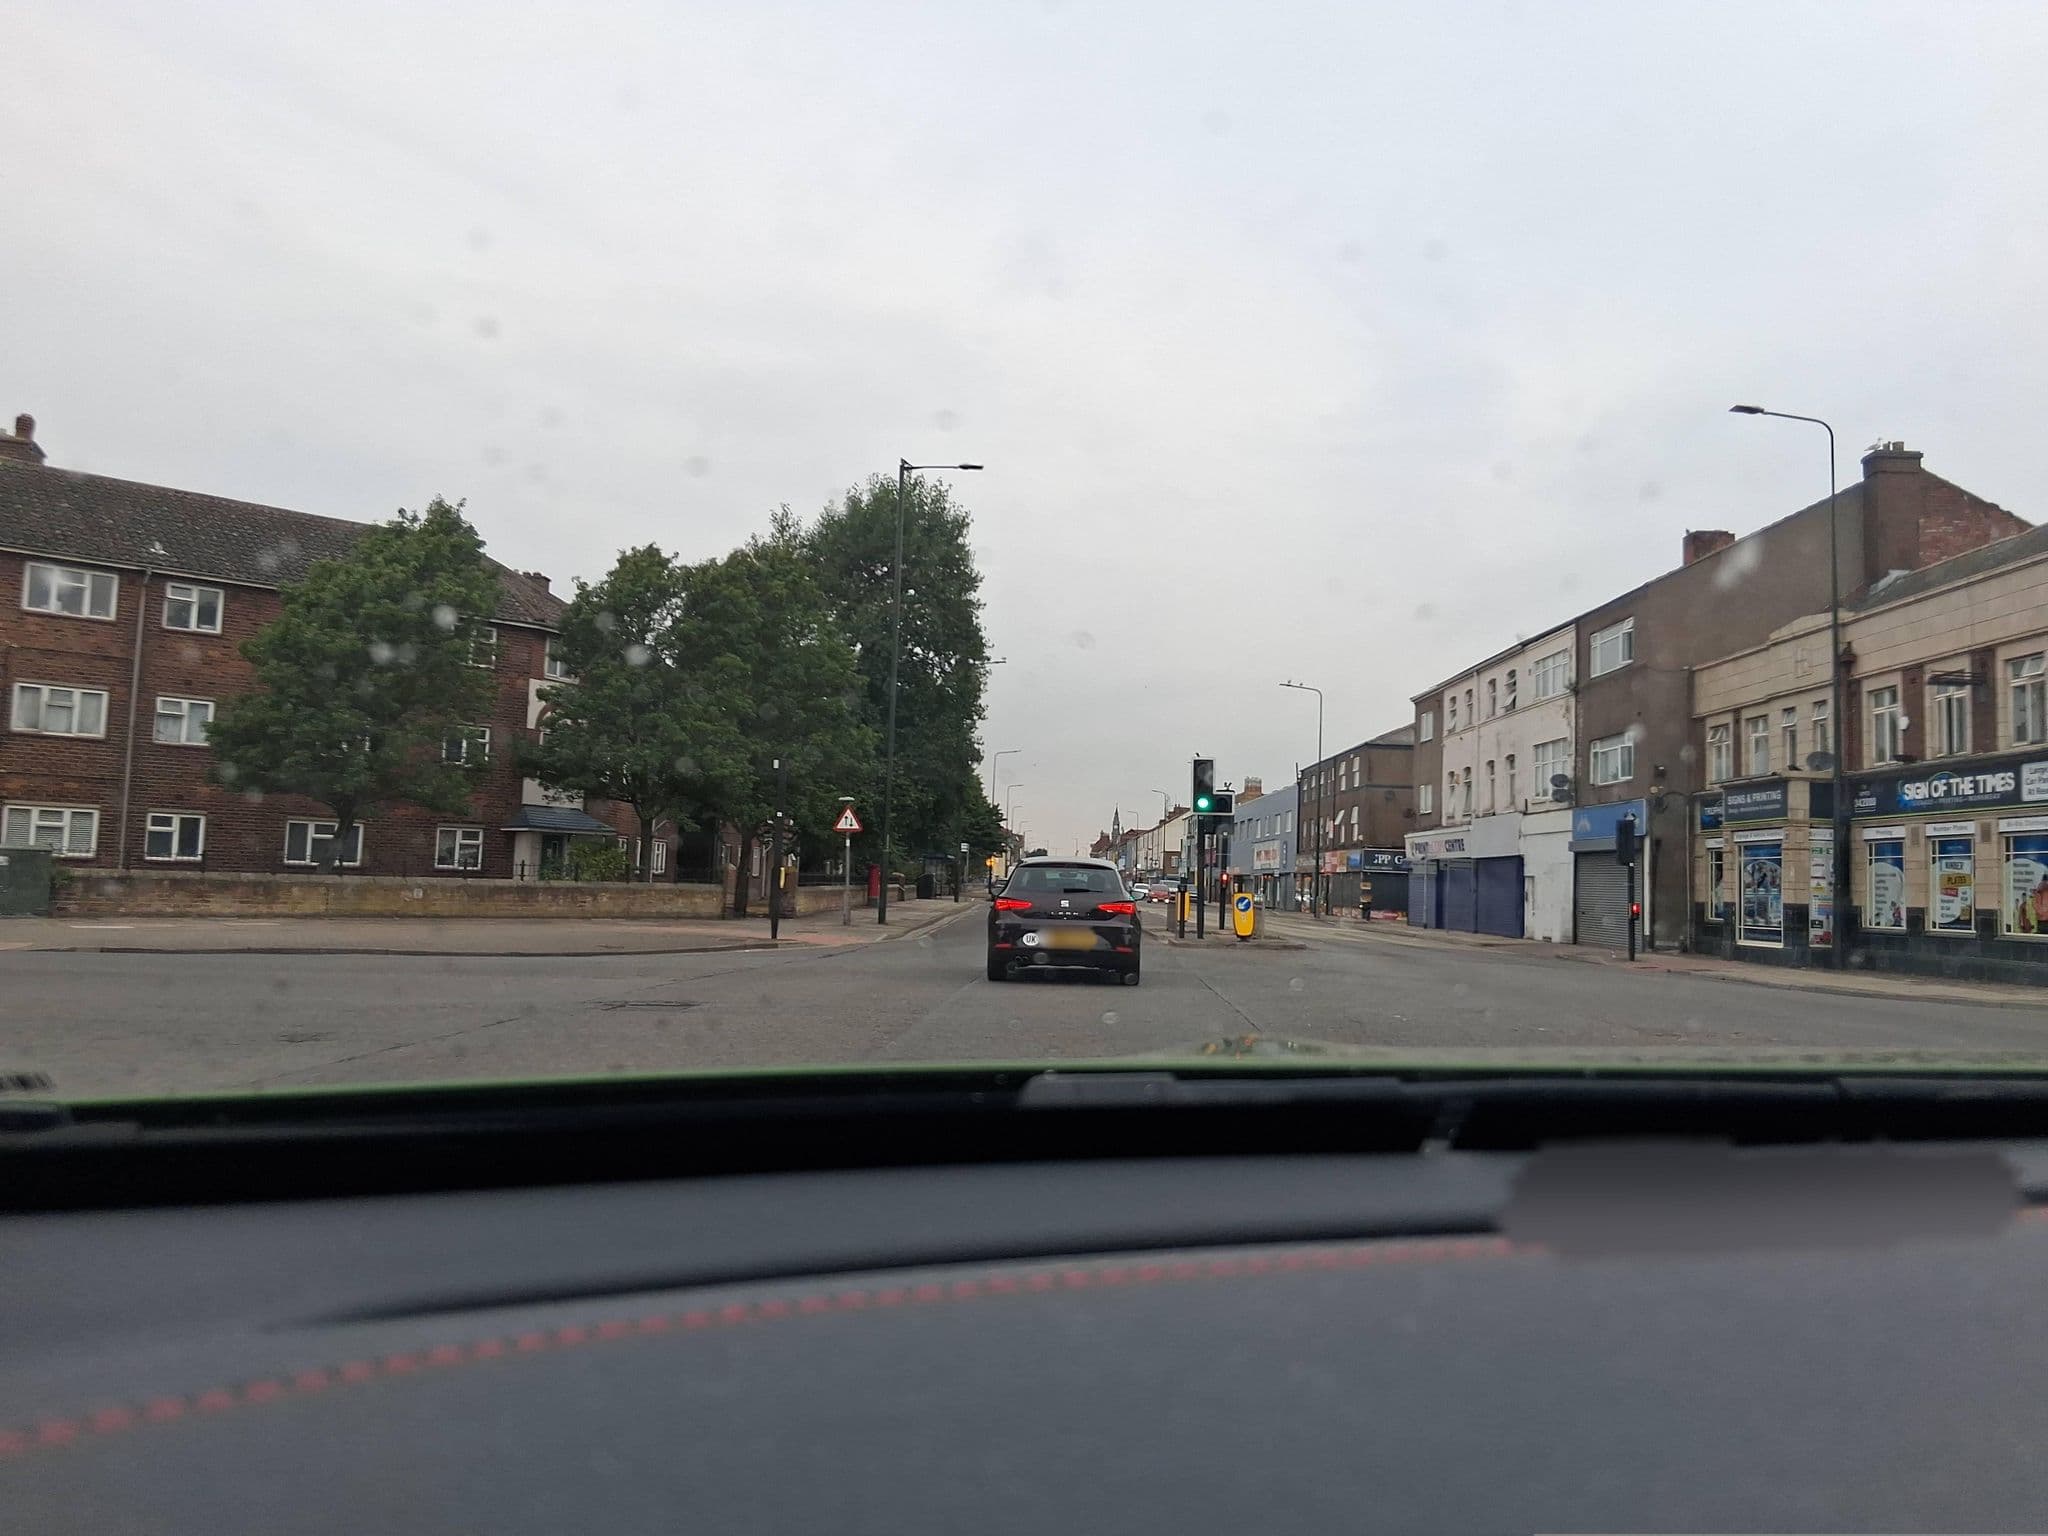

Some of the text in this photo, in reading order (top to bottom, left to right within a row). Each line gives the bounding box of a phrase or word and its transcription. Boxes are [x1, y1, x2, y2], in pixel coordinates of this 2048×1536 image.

[1904, 772, 2015, 800] SIGN OF THE TIMES
[1727, 790, 1781, 805] SIGNS & PRINTING
[1026, 935, 1037, 944] UK
